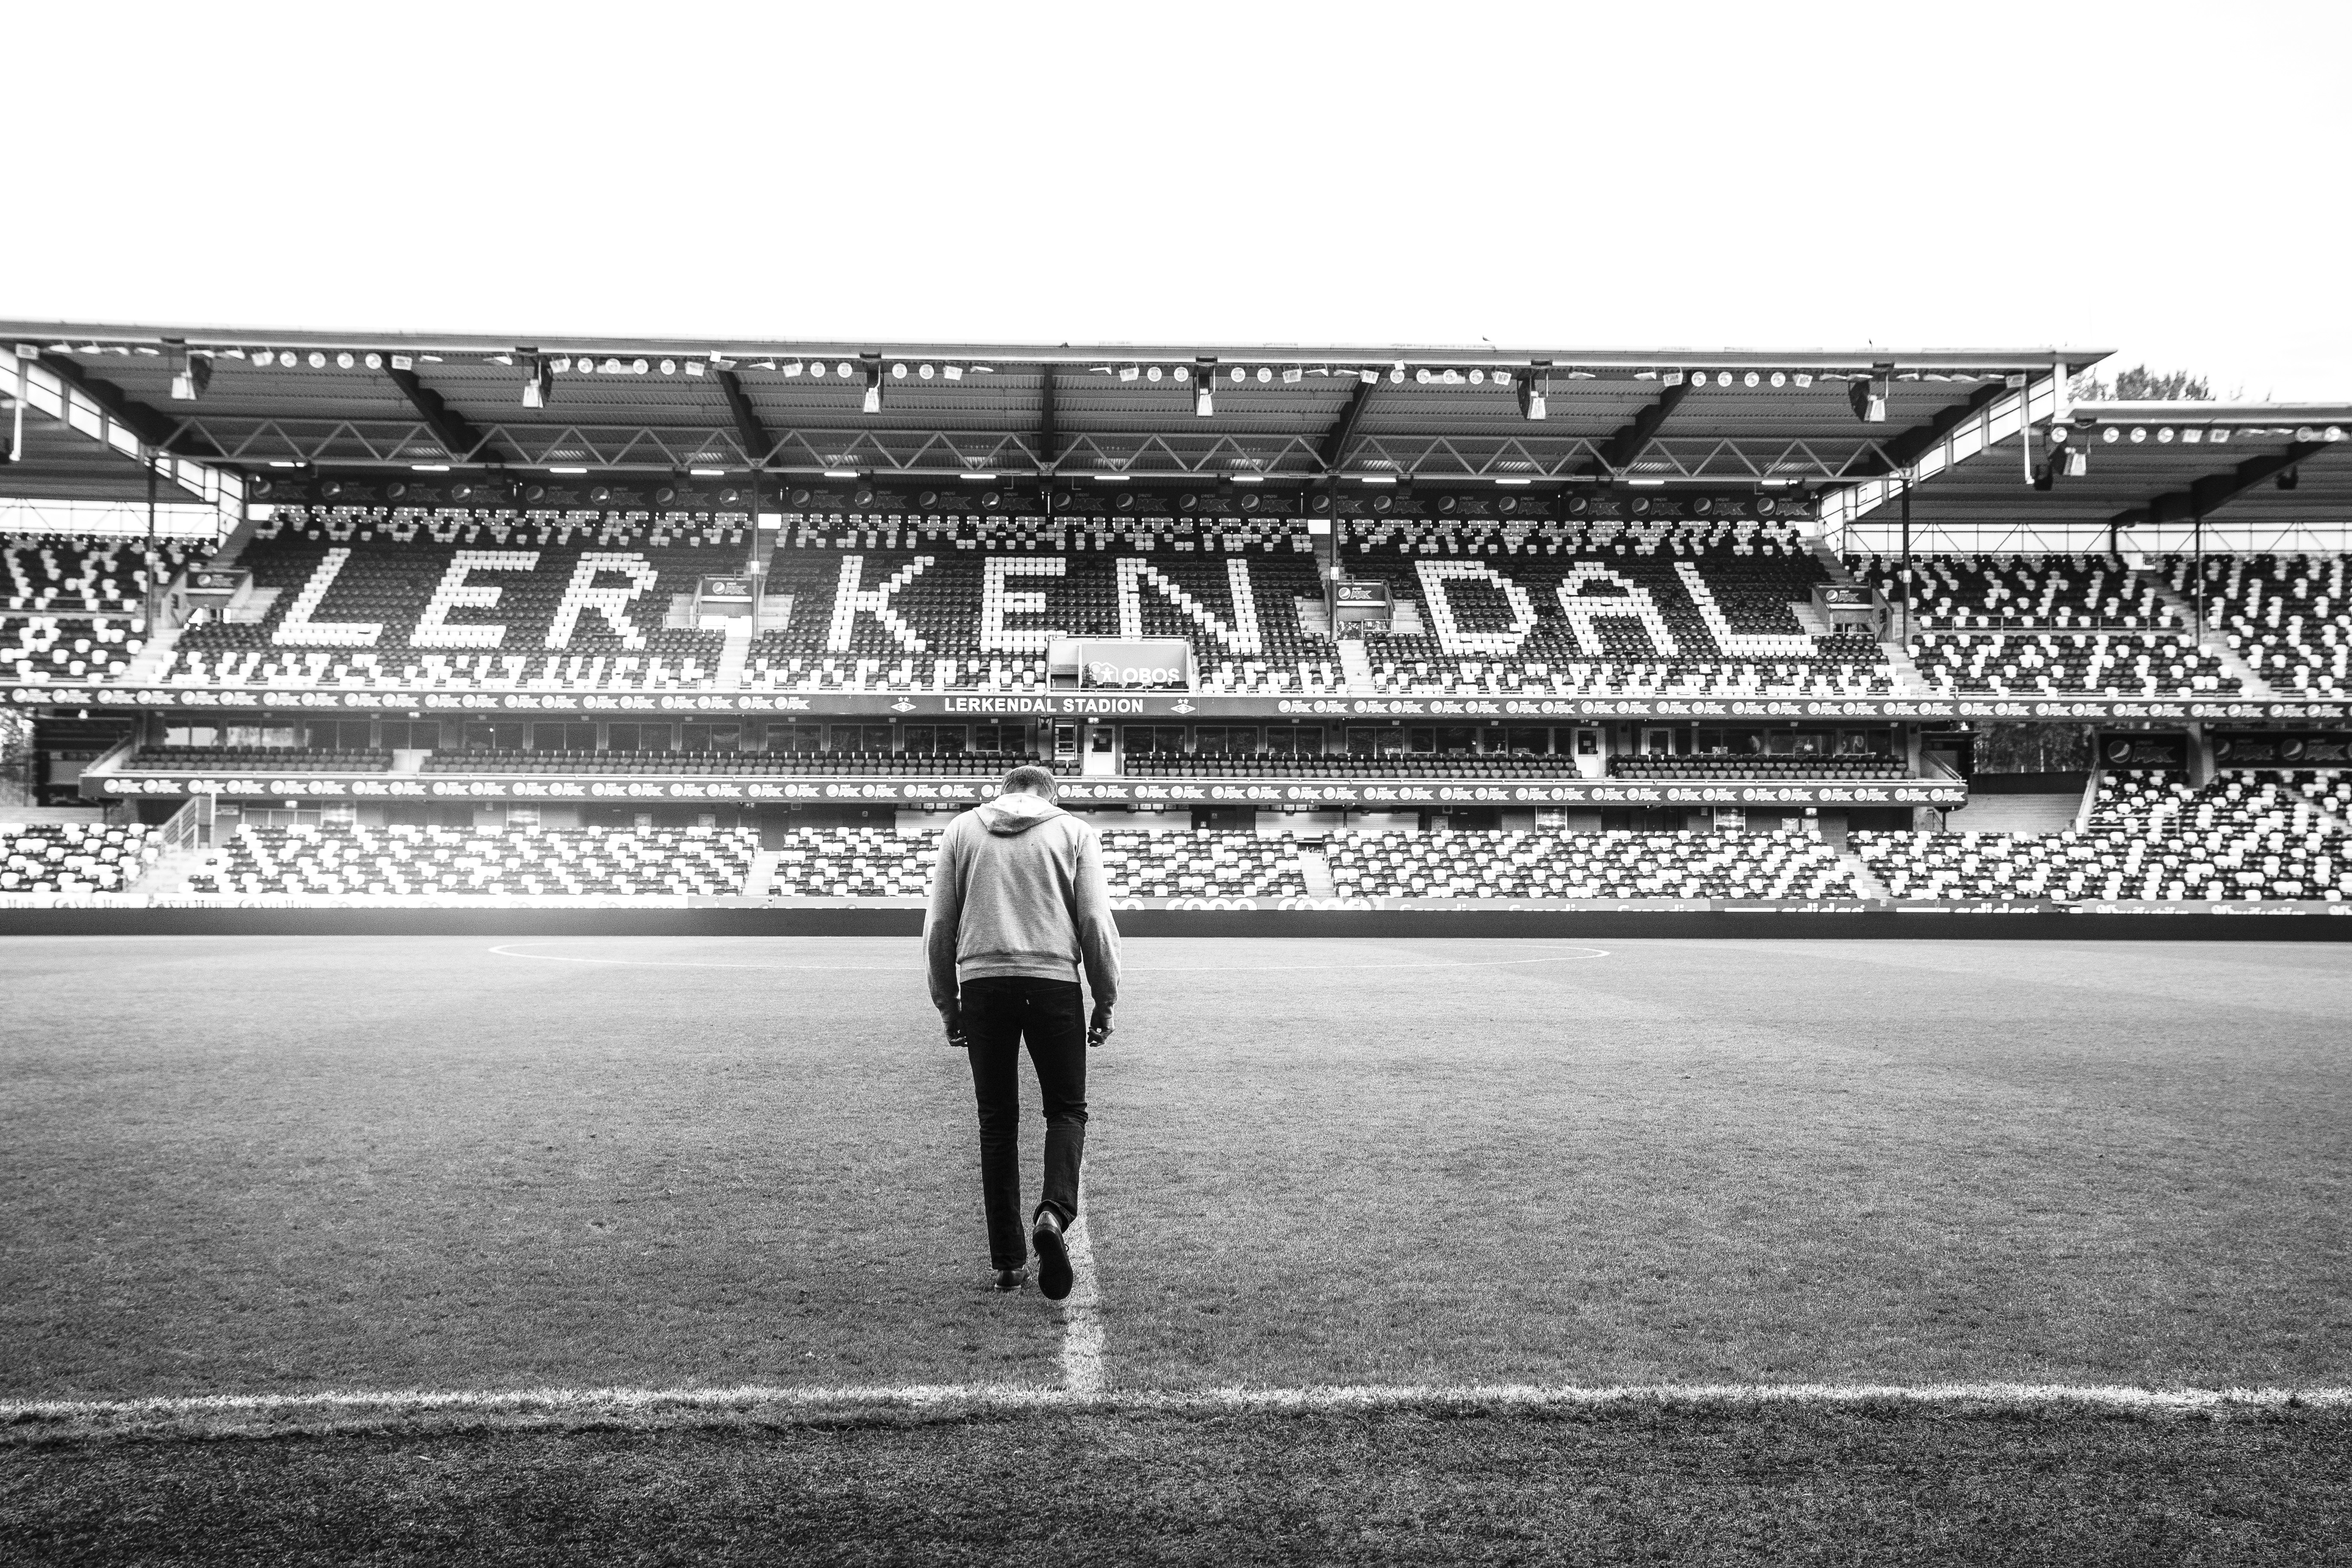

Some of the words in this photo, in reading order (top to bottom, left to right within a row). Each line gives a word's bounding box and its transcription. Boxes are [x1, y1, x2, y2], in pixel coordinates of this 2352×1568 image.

[272, 548, 658, 650] LER
[827, 554, 1262, 654] KEN
[1415, 561, 1818, 656] DAL
[1122, 667, 1180, 683] OBOS
[945, 698, 1057, 712] LERKENDAL
[1063, 698, 1143, 712] STADION
